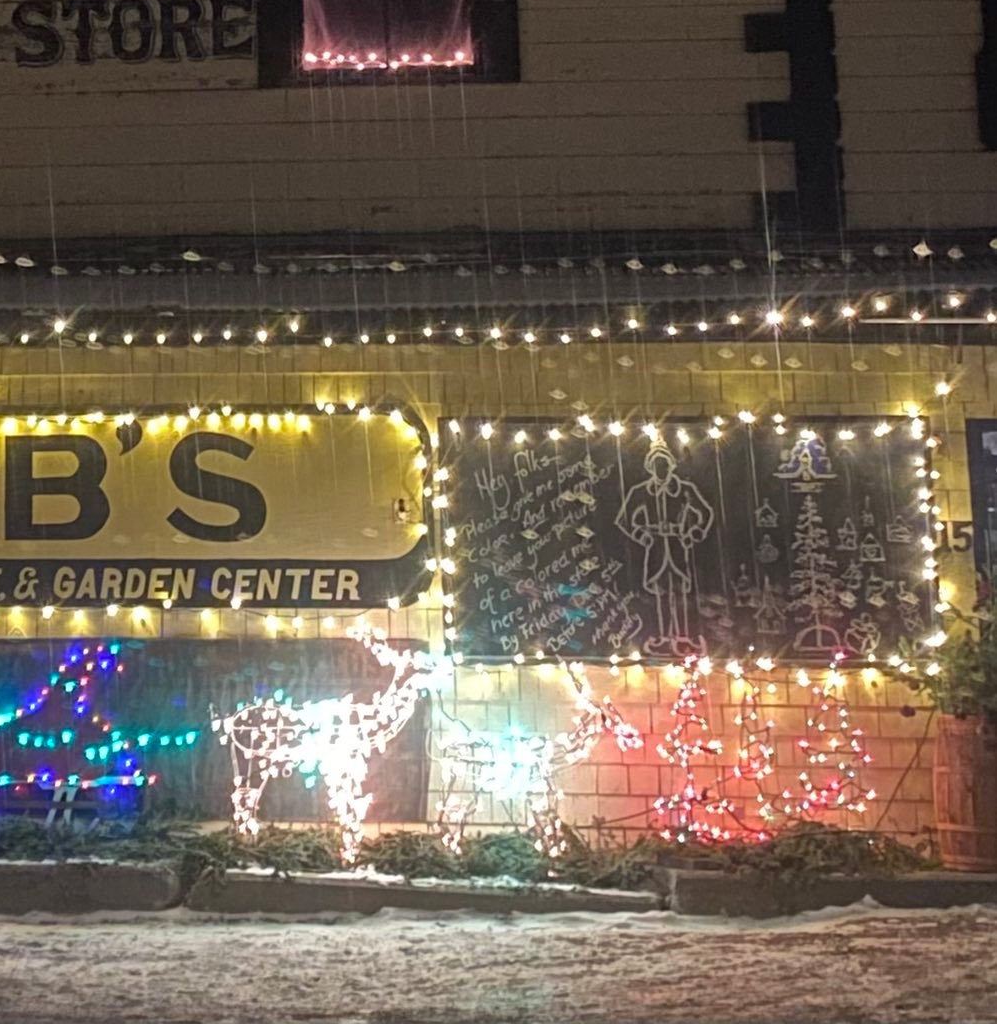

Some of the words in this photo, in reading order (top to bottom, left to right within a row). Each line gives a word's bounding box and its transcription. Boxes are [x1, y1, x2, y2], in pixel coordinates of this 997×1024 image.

[551, 464, 615, 512] reember
[13, 566, 40, 601] &
[54, 567, 197, 601] GARDEN
[210, 567, 361, 601] CENTER
[473, 573, 489, 588] to
[528, 597, 544, 613] in
[569, 555, 600, 586] stoe
[479, 587, 499, 615] of
[500, 588, 513, 600] a
